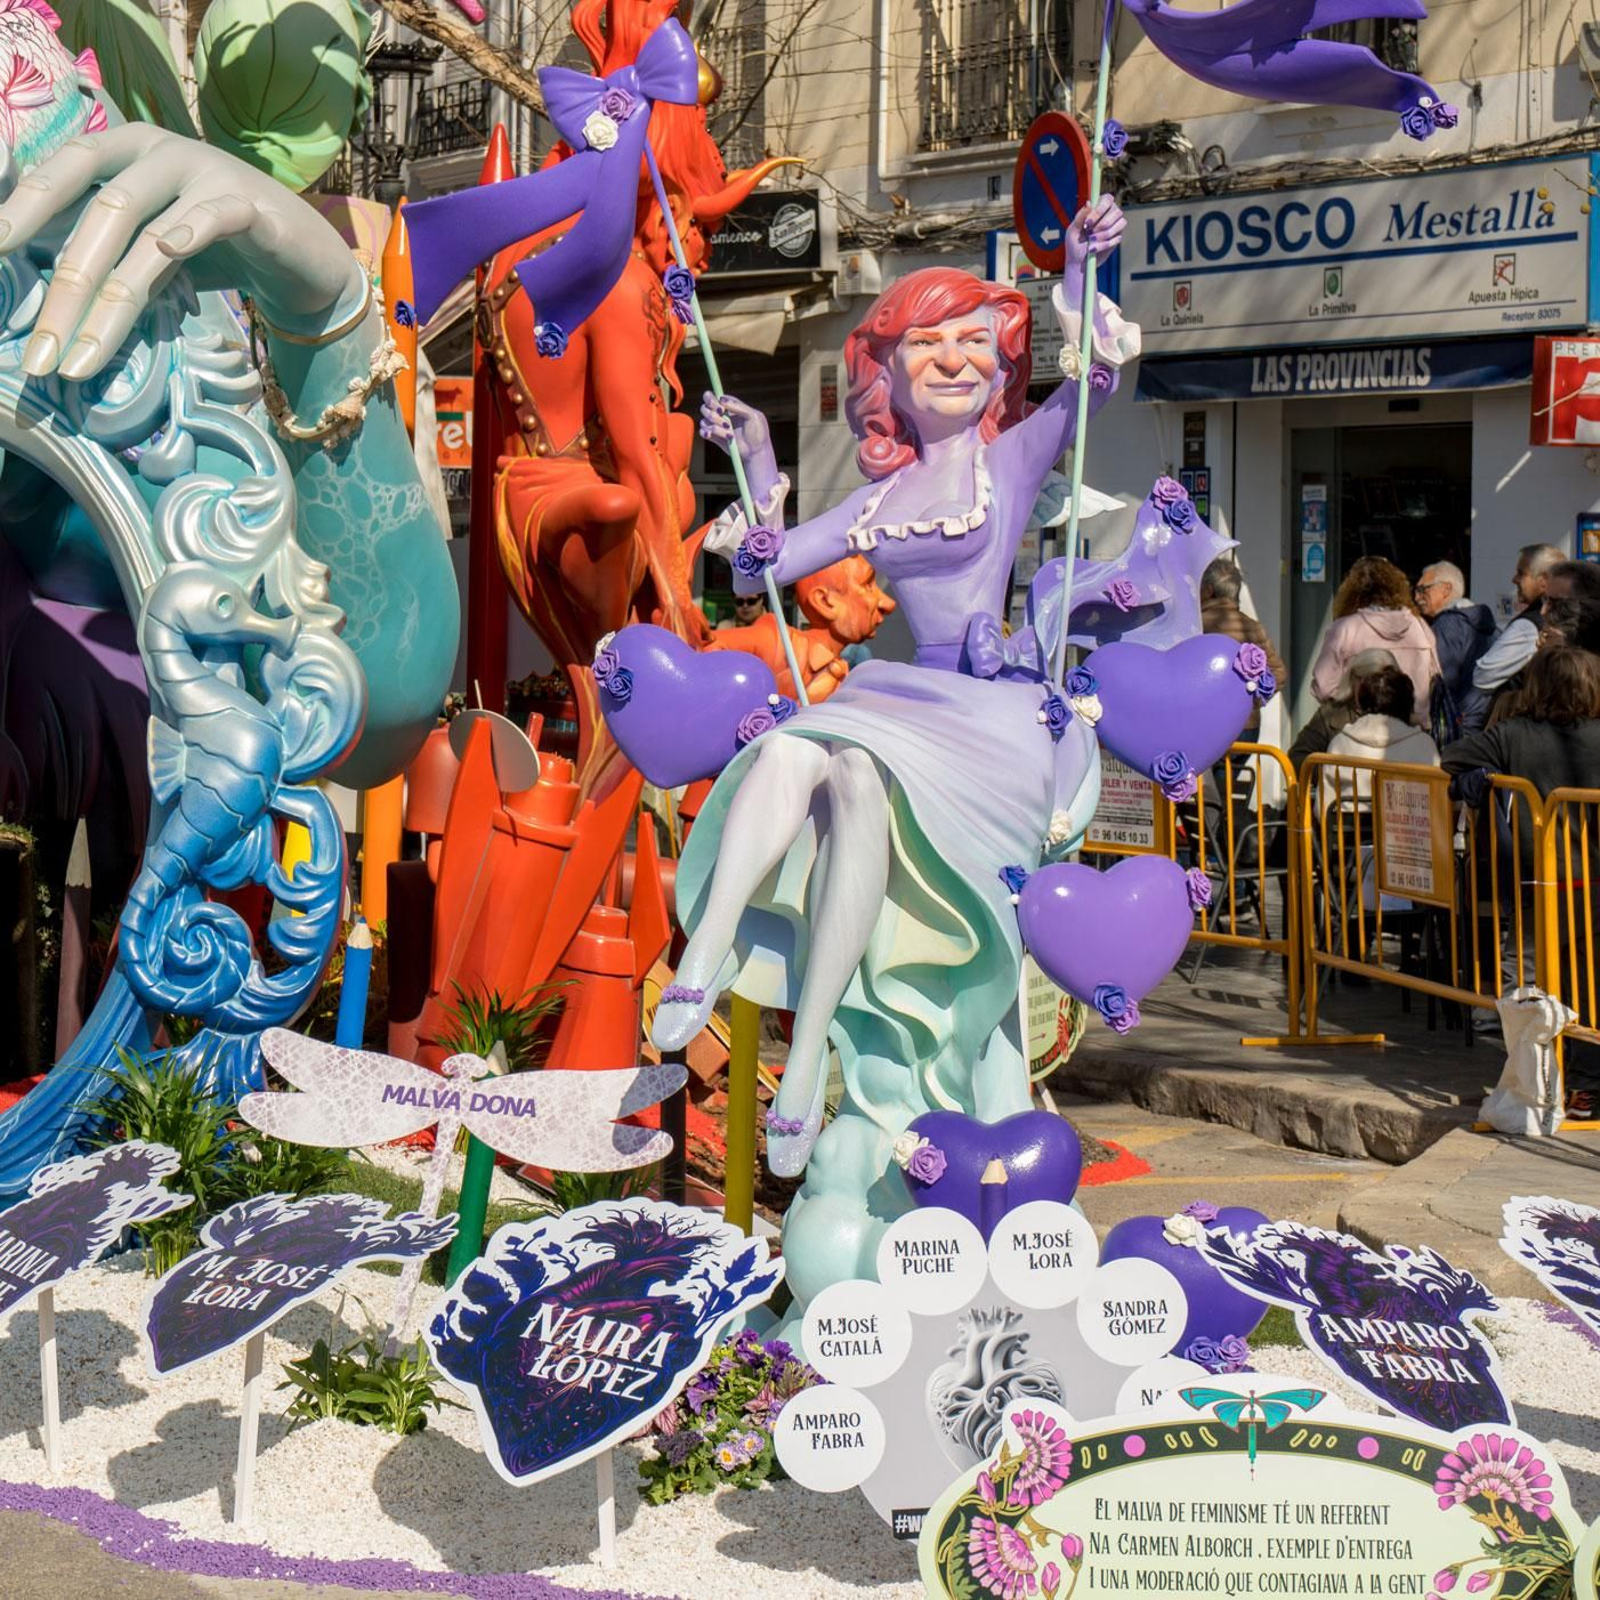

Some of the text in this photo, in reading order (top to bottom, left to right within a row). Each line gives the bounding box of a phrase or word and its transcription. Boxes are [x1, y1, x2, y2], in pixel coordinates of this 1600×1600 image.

[1145, 187, 1556, 265] KIOSCO Mestalla
[1468, 290, 1506, 304] Apuesta
[1309, 302, 1357, 317] La Primitiva
[1160, 313, 1204, 327] La Quiniela
[1251, 347, 1431, 392] LAS PROVINCIAS
[1129, 780, 1152, 791] VENTA
[1102, 829, 1149, 844] 96 145 10 33
[381, 1084, 536, 1117] MALVA DONA
[894, 1239, 960, 1257] MARINA
[903, 1257, 955, 1275] PUCHE
[1029, 1252, 1073, 1269] LORA
[189, 1254, 329, 1289] M. JOSÉ
[182, 1280, 271, 1311] LORA
[1103, 1299, 1168, 1318] SANDRA
[519, 1302, 672, 1368] NAIRA
[1108, 1317, 1166, 1336] GÓMEZ
[1318, 1314, 1470, 1350] AMPARO
[820, 1336, 883, 1357] CATALÁ
[1356, 1350, 1480, 1385] FABRA
[793, 1412, 861, 1431] AMPARO
[812, 1432, 864, 1450] FABRA
[1095, 1498, 1390, 1525] EL MALVA DE FEMINISME TÉ UN REFERENT
[1090, 1532, 1110, 1554] NA
[1118, 1533, 1178, 1556] CARMEN
[1185, 1534, 1252, 1558] ALBORCH
[1267, 1538, 1331, 1559] EXEMPLE
[1337, 1535, 1413, 1559] D'ENTREGA
[1089, 1566, 1426, 1596] I UNA MODERACIÓ QUE CONTAGIAVA A LA GENT
